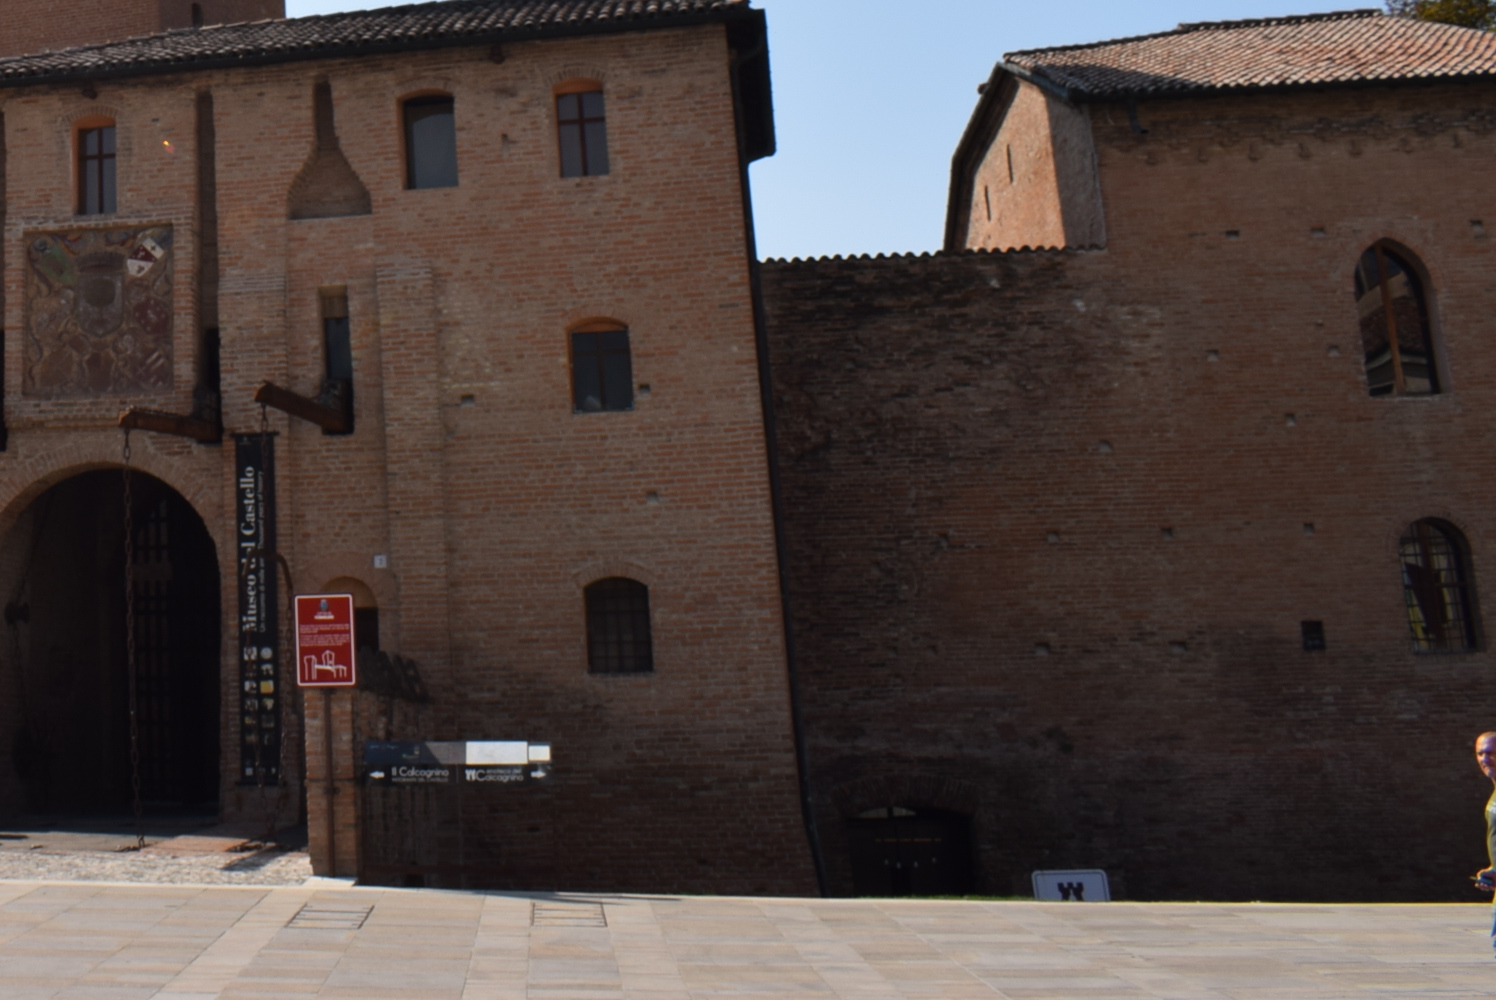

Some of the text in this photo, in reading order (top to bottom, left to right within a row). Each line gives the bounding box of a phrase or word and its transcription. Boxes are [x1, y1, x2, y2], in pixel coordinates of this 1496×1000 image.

[239, 465, 256, 536] Castello
[241, 573, 258, 633] Museo
[399, 766, 450, 779] Calcagnino
